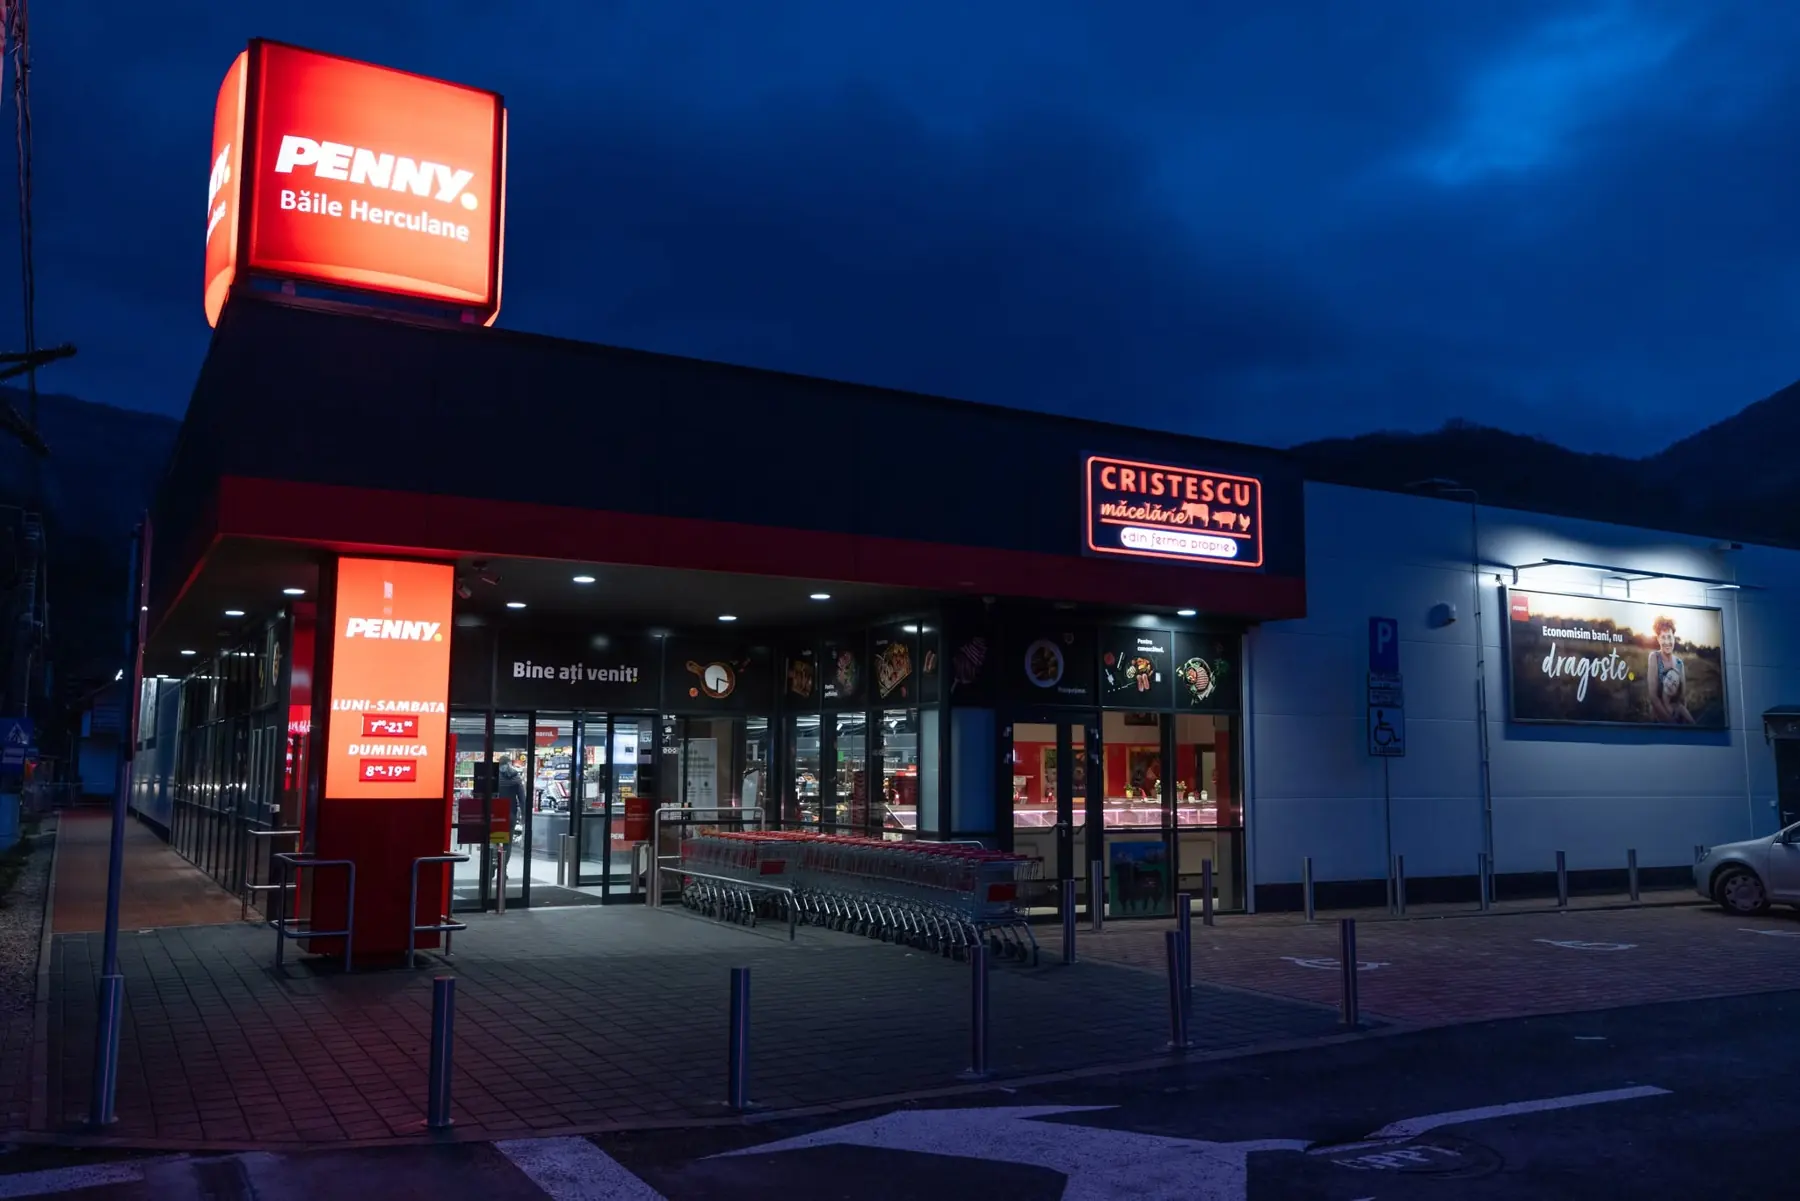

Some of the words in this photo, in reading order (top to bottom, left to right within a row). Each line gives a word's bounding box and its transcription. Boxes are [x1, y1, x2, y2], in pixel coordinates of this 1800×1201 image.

[280, 189, 342, 217] Băile
[350, 199, 470, 242] Herculane
[1101, 466, 1250, 506] CRISTESCU
[1101, 500, 1189, 524] măcelărie
[1128, 532, 1147, 543] din
[1150, 532, 1187, 548] ferma
[1191, 539, 1230, 552] proprie
[1377, 621, 1392, 654] P
[1542, 625, 1591, 641] Economisim
[1592, 630, 1611, 643] bani,
[1612, 633, 1623, 642] nu
[513, 660, 555, 679] Bine
[559, 663, 583, 684] ați
[587, 665, 638, 682] venit!
[332, 699, 446, 713] LUNI-SAMBATA
[348, 744, 428, 757] DUMINICA
